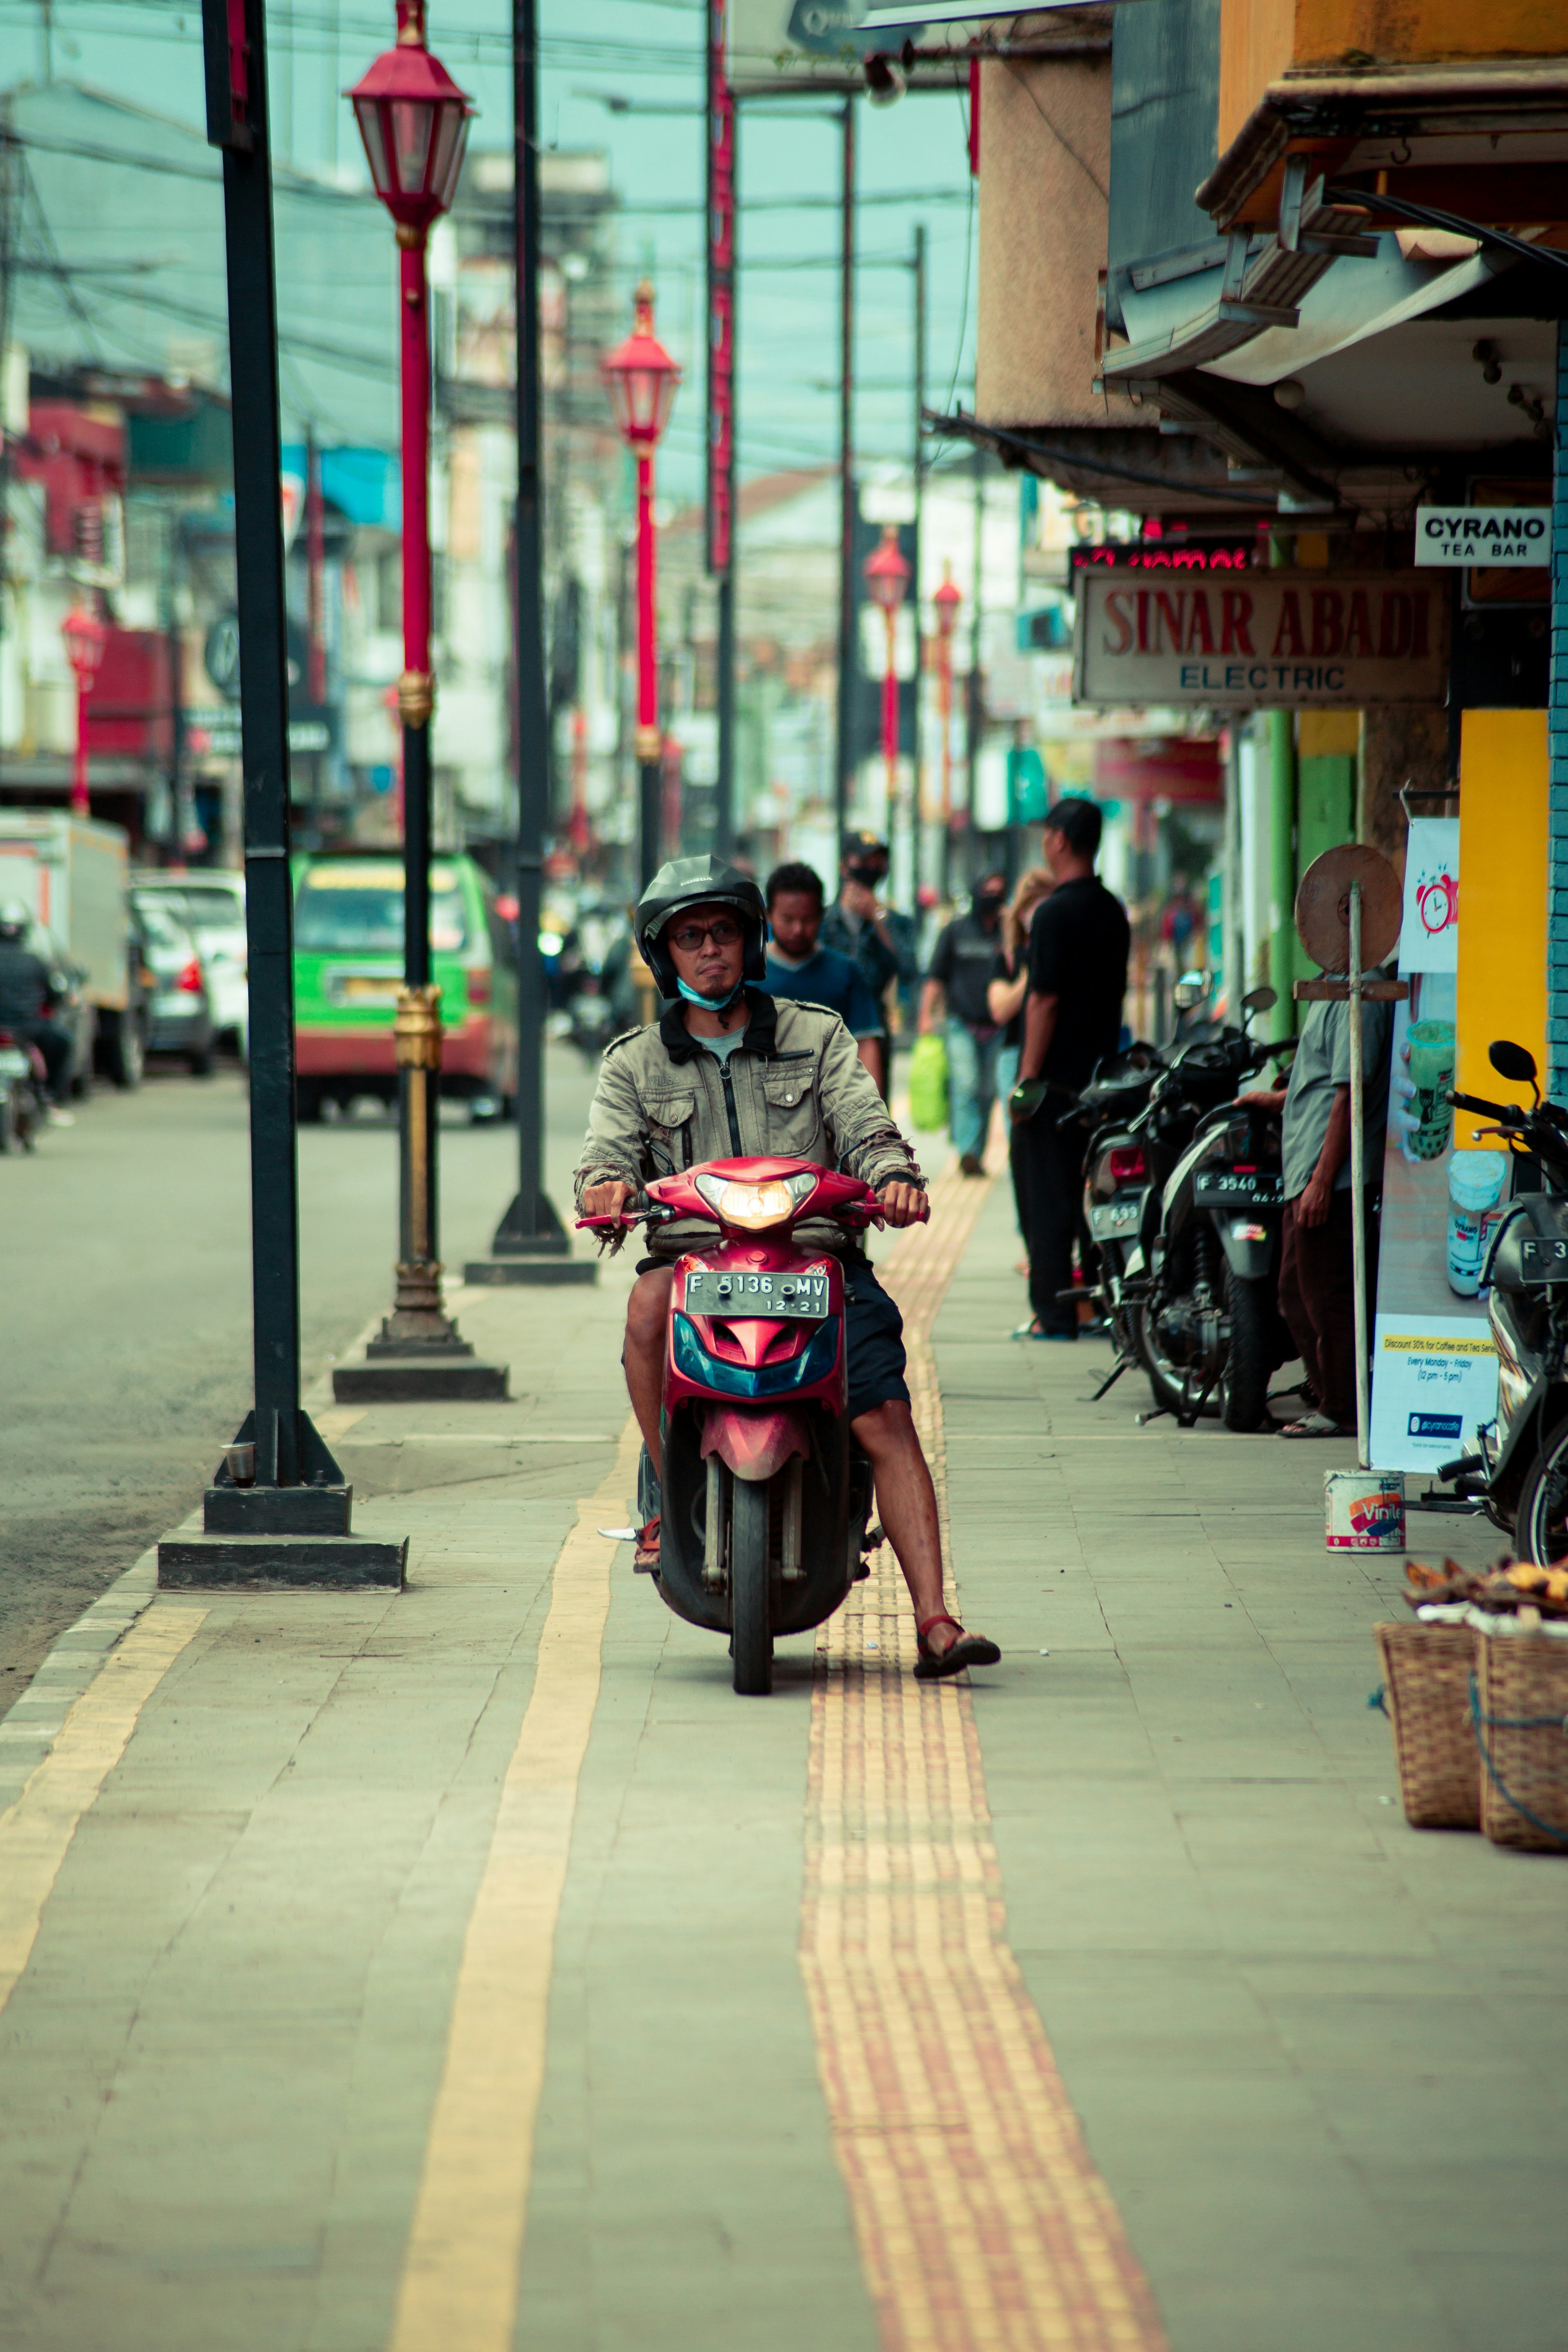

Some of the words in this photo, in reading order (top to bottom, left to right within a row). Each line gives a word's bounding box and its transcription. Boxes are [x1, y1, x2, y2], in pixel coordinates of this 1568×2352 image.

[1425, 518, 1545, 539] CYRANO
[1441, 543, 1474, 556] TEA
[1492, 543, 1527, 556] BAR
[1104, 589, 1255, 655] SINAR
[1273, 589, 1432, 656] ABADI
[1181, 665, 1344, 690] ELECTRIC
[680, 877, 713, 887] HONDA
[1200, 1177, 1209, 1191] F
[1218, 1176, 1257, 1191] 3540
[1524, 1242, 1536, 1259] F
[690, 1276, 702, 1293] F
[720, 1276, 773, 1294] 5136
[797, 1278, 824, 1296] MV
[1385, 1339, 1411, 1349] Discount
[1412, 1339, 1424, 1350] 30%
[1425, 1340, 1434, 1350] for
[1435, 1341, 1454, 1351] Coffee
[1457, 1343, 1468, 1352] and
[1469, 1343, 1479, 1352] Tea
[1408, 1356, 1424, 1368] Every
[1425, 1358, 1449, 1370] Monday
[1454, 1359, 1472, 1371] Friday
[1427, 1372, 1438, 1382] pm
[1362, 1503, 1405, 1521] Vinile
